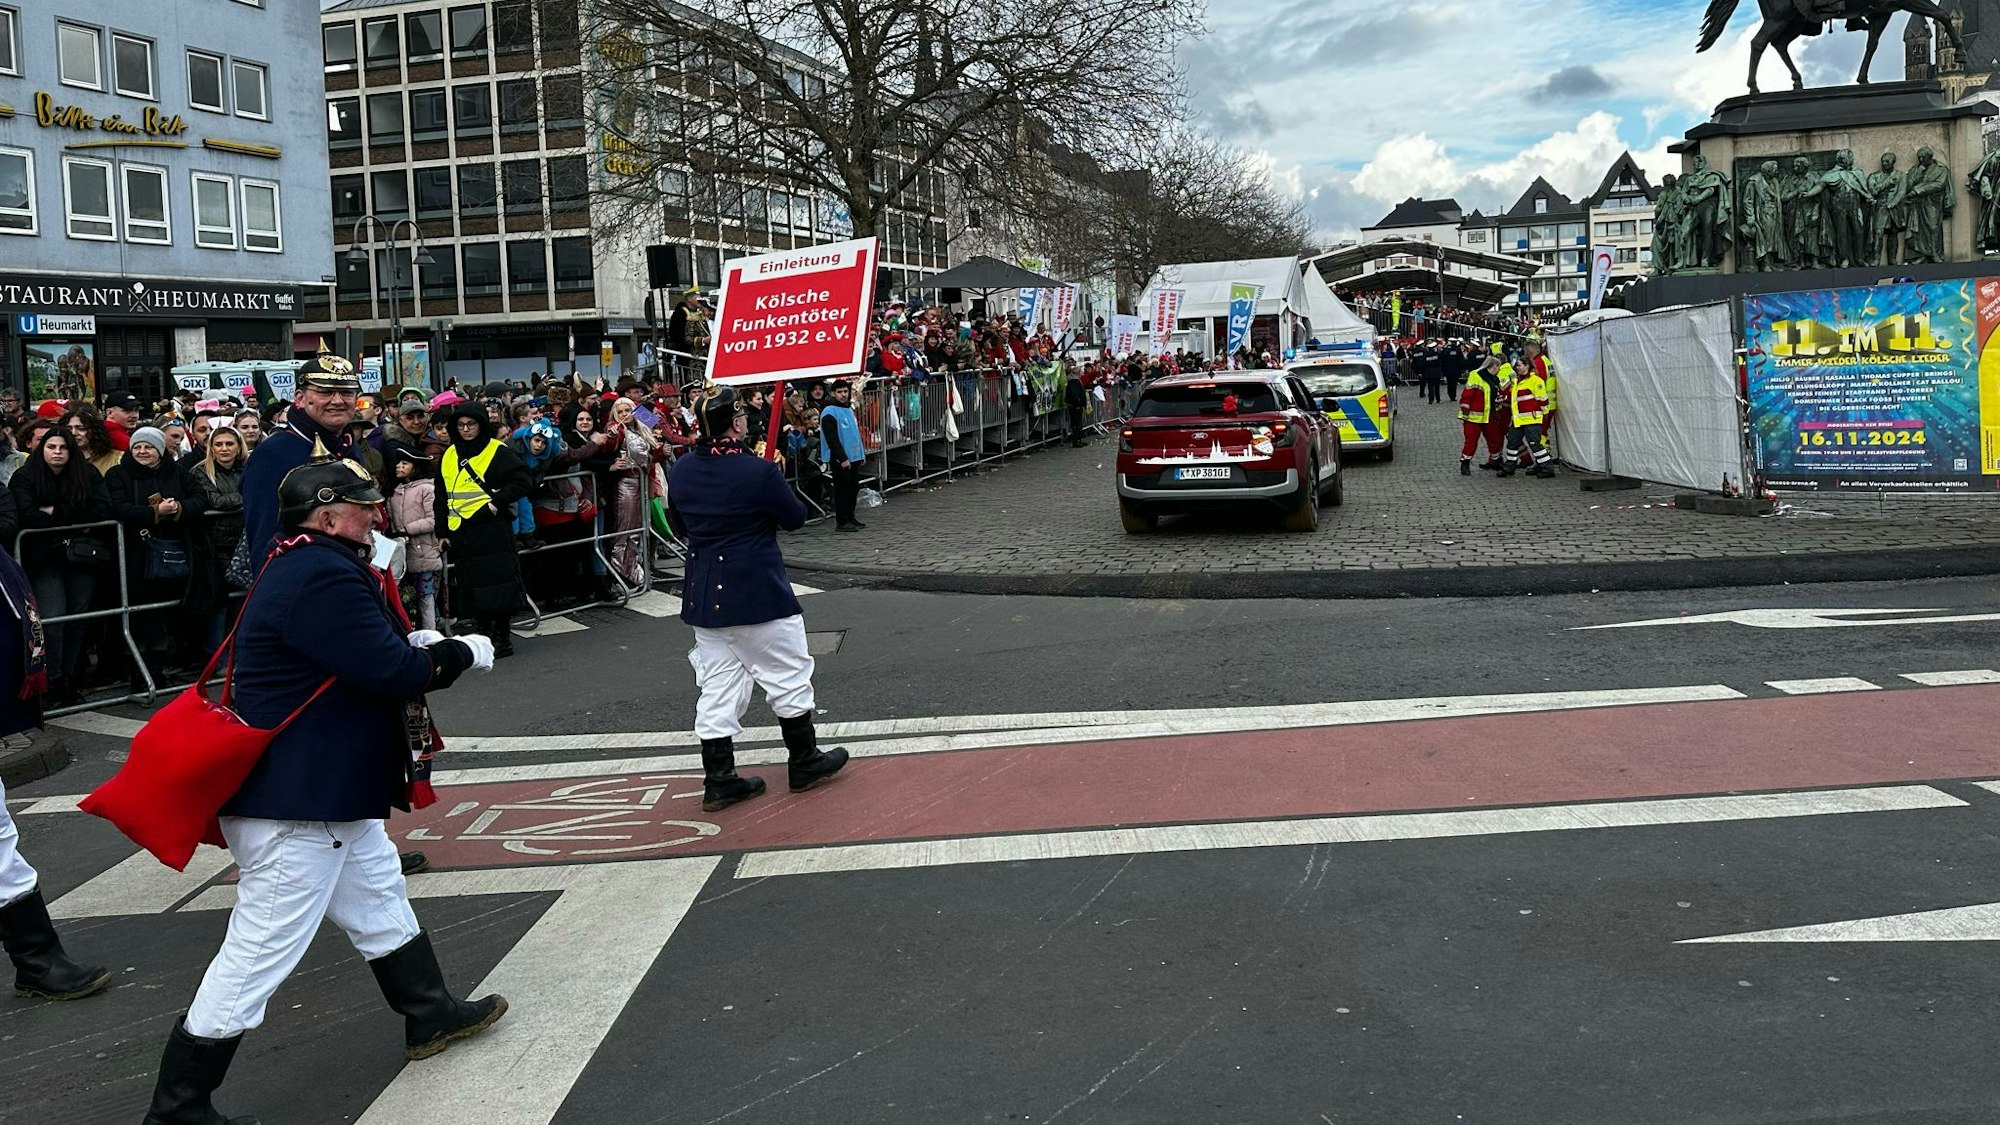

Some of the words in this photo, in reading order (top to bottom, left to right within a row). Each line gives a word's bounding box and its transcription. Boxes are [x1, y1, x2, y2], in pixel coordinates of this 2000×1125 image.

[34, 91, 96, 130] Bitte
[101, 114, 142, 135] ein
[143, 106, 188, 136] Bit
[759, 253, 841, 274] Einleitung
[0, 284, 123, 306] TAURANT
[153, 290, 271, 310] HEUMARKT
[275, 294, 294, 304] Gaffel
[755, 289, 830, 311] Kölsche
[1168, 292, 1177, 312] ALLE
[732, 307, 849, 333] Funkentöter
[1157, 292, 1167, 332] KARNEVAL
[20, 316, 34, 332] U
[40, 318, 93, 331] Heumarkt
[501, 324, 564, 334] STRATHMANN
[1771, 319, 1832, 357] 11.
[1838, 326, 1879, 353] IM
[1886, 311, 1953, 352] 11.
[723, 338, 757, 354] von
[763, 330, 810, 349] 1932
[815, 325, 850, 343] e.V.
[1775, 358, 1813, 367] IMMER
[1817, 356, 1857, 366] WIEDER
[1862, 354, 1907, 365] KÖLSCHE
[1911, 354, 1950, 364] LIEDER
[1800, 430, 1926, 446] 16.11.2024
